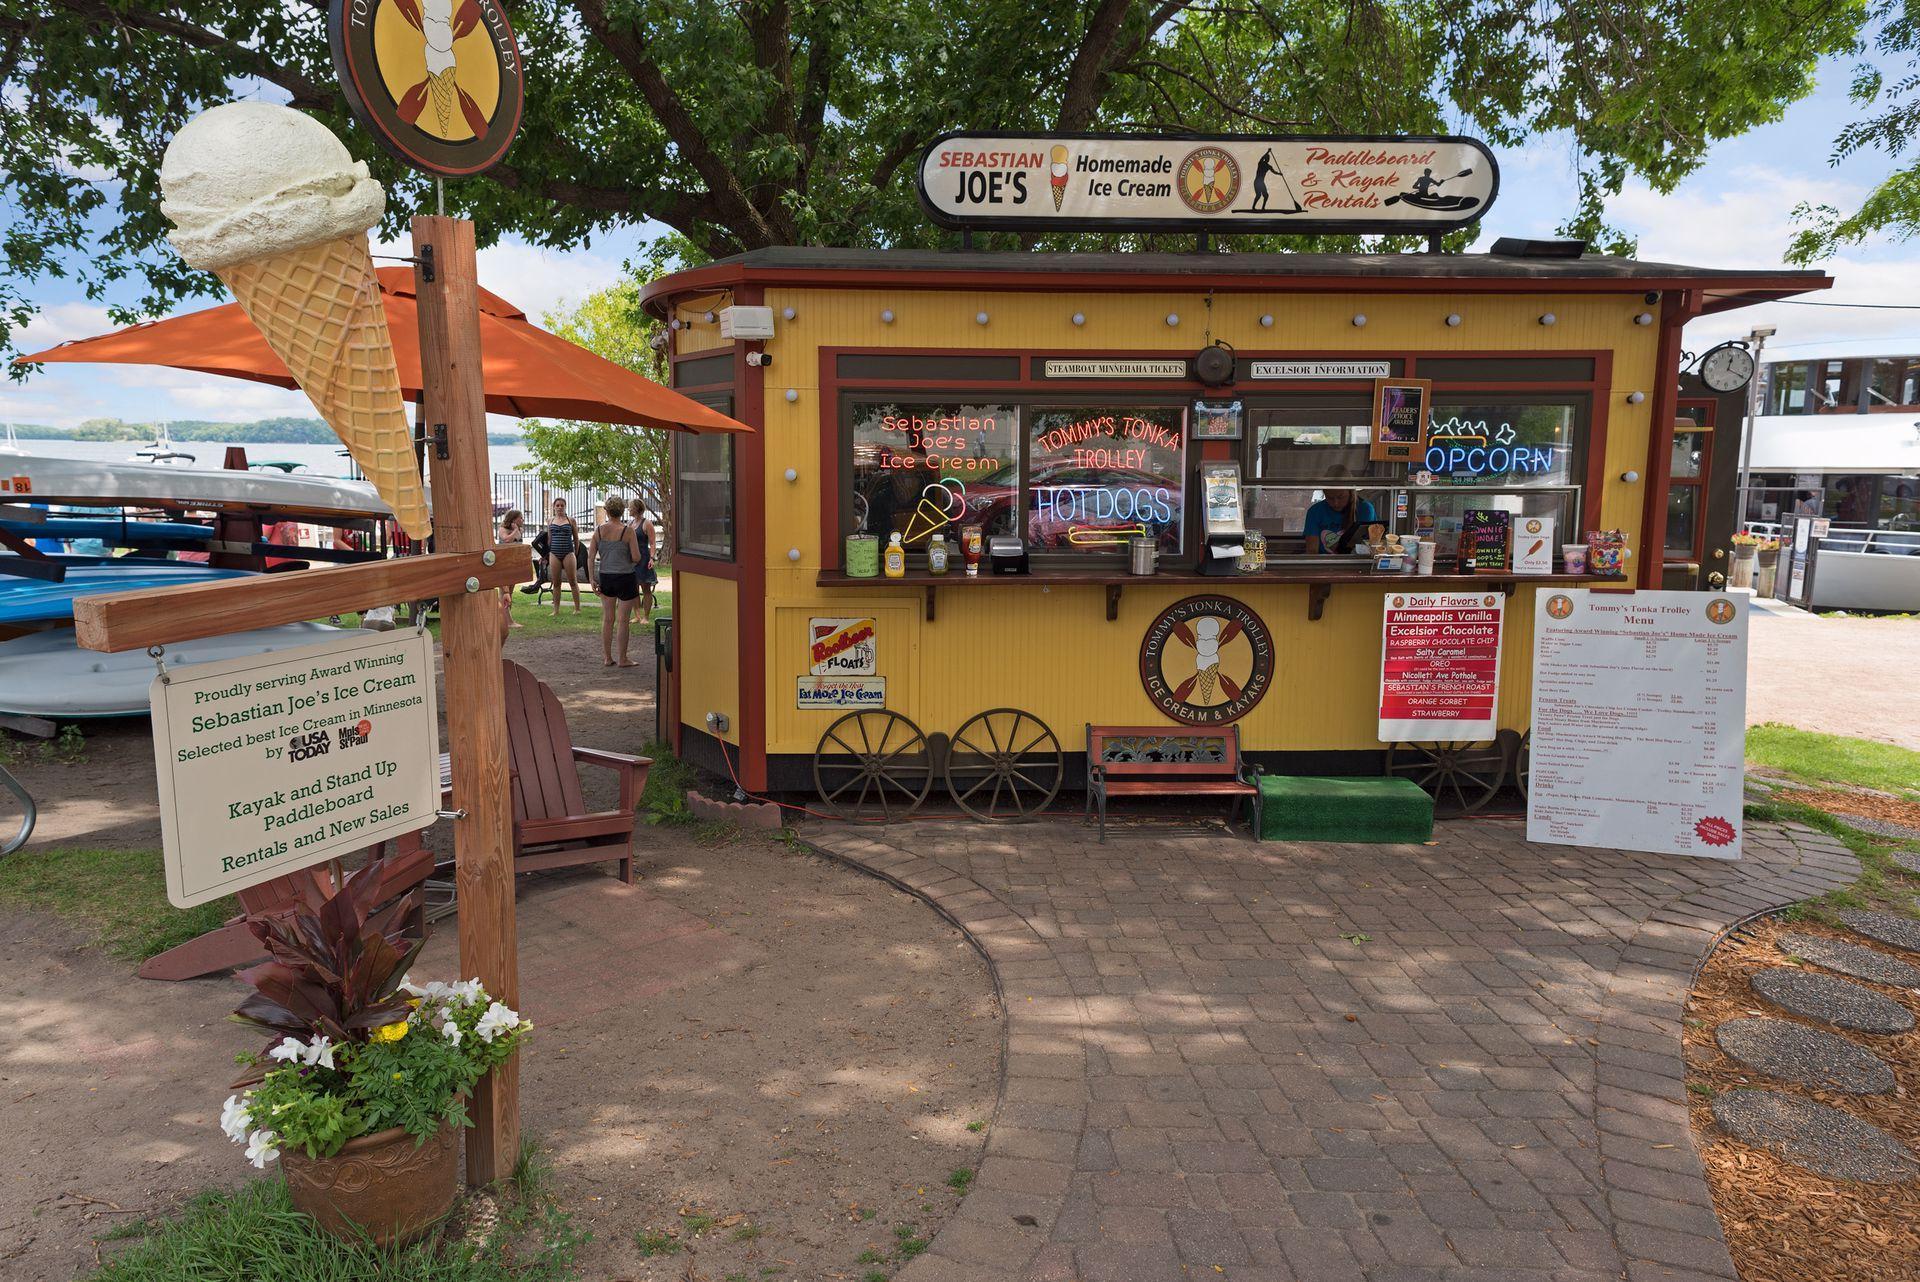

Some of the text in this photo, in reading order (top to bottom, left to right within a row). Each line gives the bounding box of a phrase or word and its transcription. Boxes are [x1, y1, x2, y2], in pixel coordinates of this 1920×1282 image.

[940, 151, 1044, 168] SEBASTIAN
[1076, 155, 1172, 173] Homemade
[1306, 147, 1436, 165] Paddleboard
[955, 171, 1027, 204] JOE'S
[1088, 179, 1171, 197] Ice Cream
[1301, 170, 1400, 193] & Kayak
[1303, 190, 1380, 209] Rentals
[1048, 364, 1183, 373] STEAMBOAT MINNEHAHA TICKETS
[1256, 365, 1386, 374] EXCELSIOR INFORMATION
[882, 416, 995, 431] Sebastian
[909, 434, 966, 450] Joe's
[1037, 416, 1179, 453] TOMMY'S TONKA
[880, 453, 998, 470] Ice Cream
[1074, 448, 1146, 469] TROLLEY
[1424, 447, 1553, 472] OPCORN
[1037, 487, 1171, 522] HOT DOGS
[1410, 596, 1478, 608] Daily Flavors
[1589, 604, 1691, 615] Tommy's Tonka Trolley
[1393, 611, 1492, 623] Minneapolis Vanilla
[1624, 615, 1654, 625] Menu
[1145, 601, 1269, 657] TOMMY'S TONKA TROLLEY
[1390, 626, 1494, 636] Excelsior Chocolate
[1390, 639, 1430, 647] RASPBERRY
[1432, 638, 1475, 646] CHOCOLATE
[1416, 648, 1466, 656] Salty Caramel
[827, 657, 864, 669] FLOATS
[1430, 660, 1450, 668] OREO
[194, 653, 405, 704] Proudly serving Award Winning
[1451, 671, 1477, 679] Pothole
[192, 672, 416, 733] Sebastian Joe's Ice Cream
[856, 688, 882, 700] Cream
[1147, 674, 1266, 721] ICE CREAM & KAYAKS
[177, 695, 423, 762] Selected best Ice Cream in Minnesota
[339, 726, 360, 741] Mpls
[302, 730, 330, 747] USA
[265, 746, 283, 760] by
[288, 741, 331, 763] TODAY
[228, 760, 398, 820] Kayak and Stand Up
[264, 786, 374, 831] Paddleboard
[221, 802, 410, 873] Rentals and New Sales
